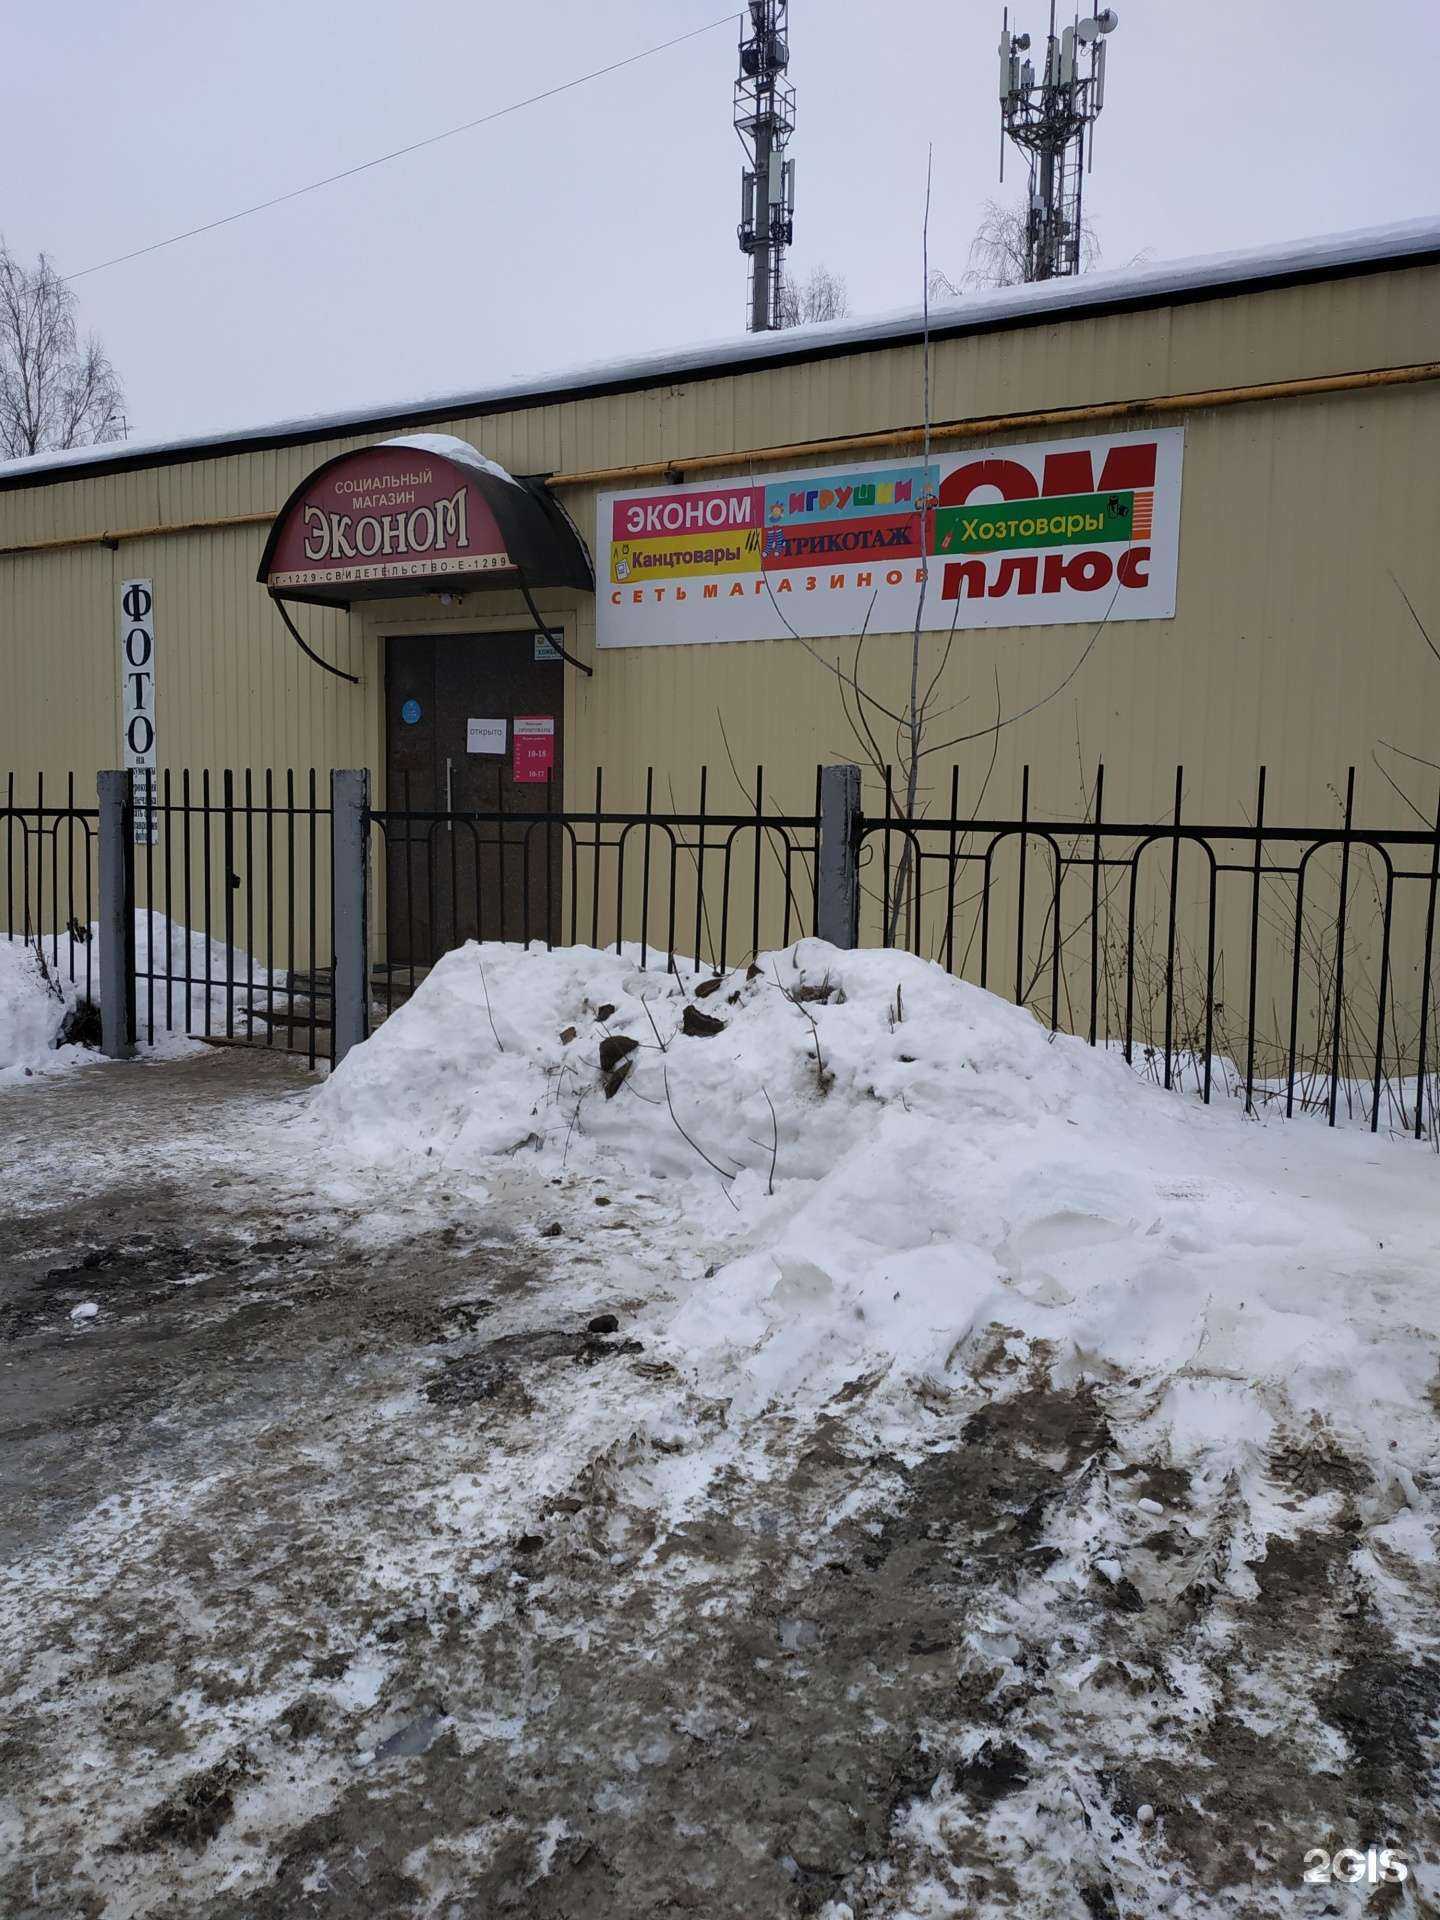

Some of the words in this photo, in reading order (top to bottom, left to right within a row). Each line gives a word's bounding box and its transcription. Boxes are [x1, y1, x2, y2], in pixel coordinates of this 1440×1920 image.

[335, 467, 432, 494] СОЦИАЛЬНЫЙ
[789, 478, 912, 514] ИГРУШКИ
[352, 492, 415, 510] МАГАЗИН
[627, 496, 750, 533] ЭКОНОМ
[304, 486, 470, 561] ЭКОНОМ
[961, 512, 1104, 543] Хозтовары
[632, 545, 741, 570] Канцтовары
[785, 526, 913, 557] ТРИКОТАЖ
[611, 587, 687, 605] СЕТЬ
[703, 568, 928, 598] МАГАЗИНОВ
[122, 584, 154, 754] ФОТО
